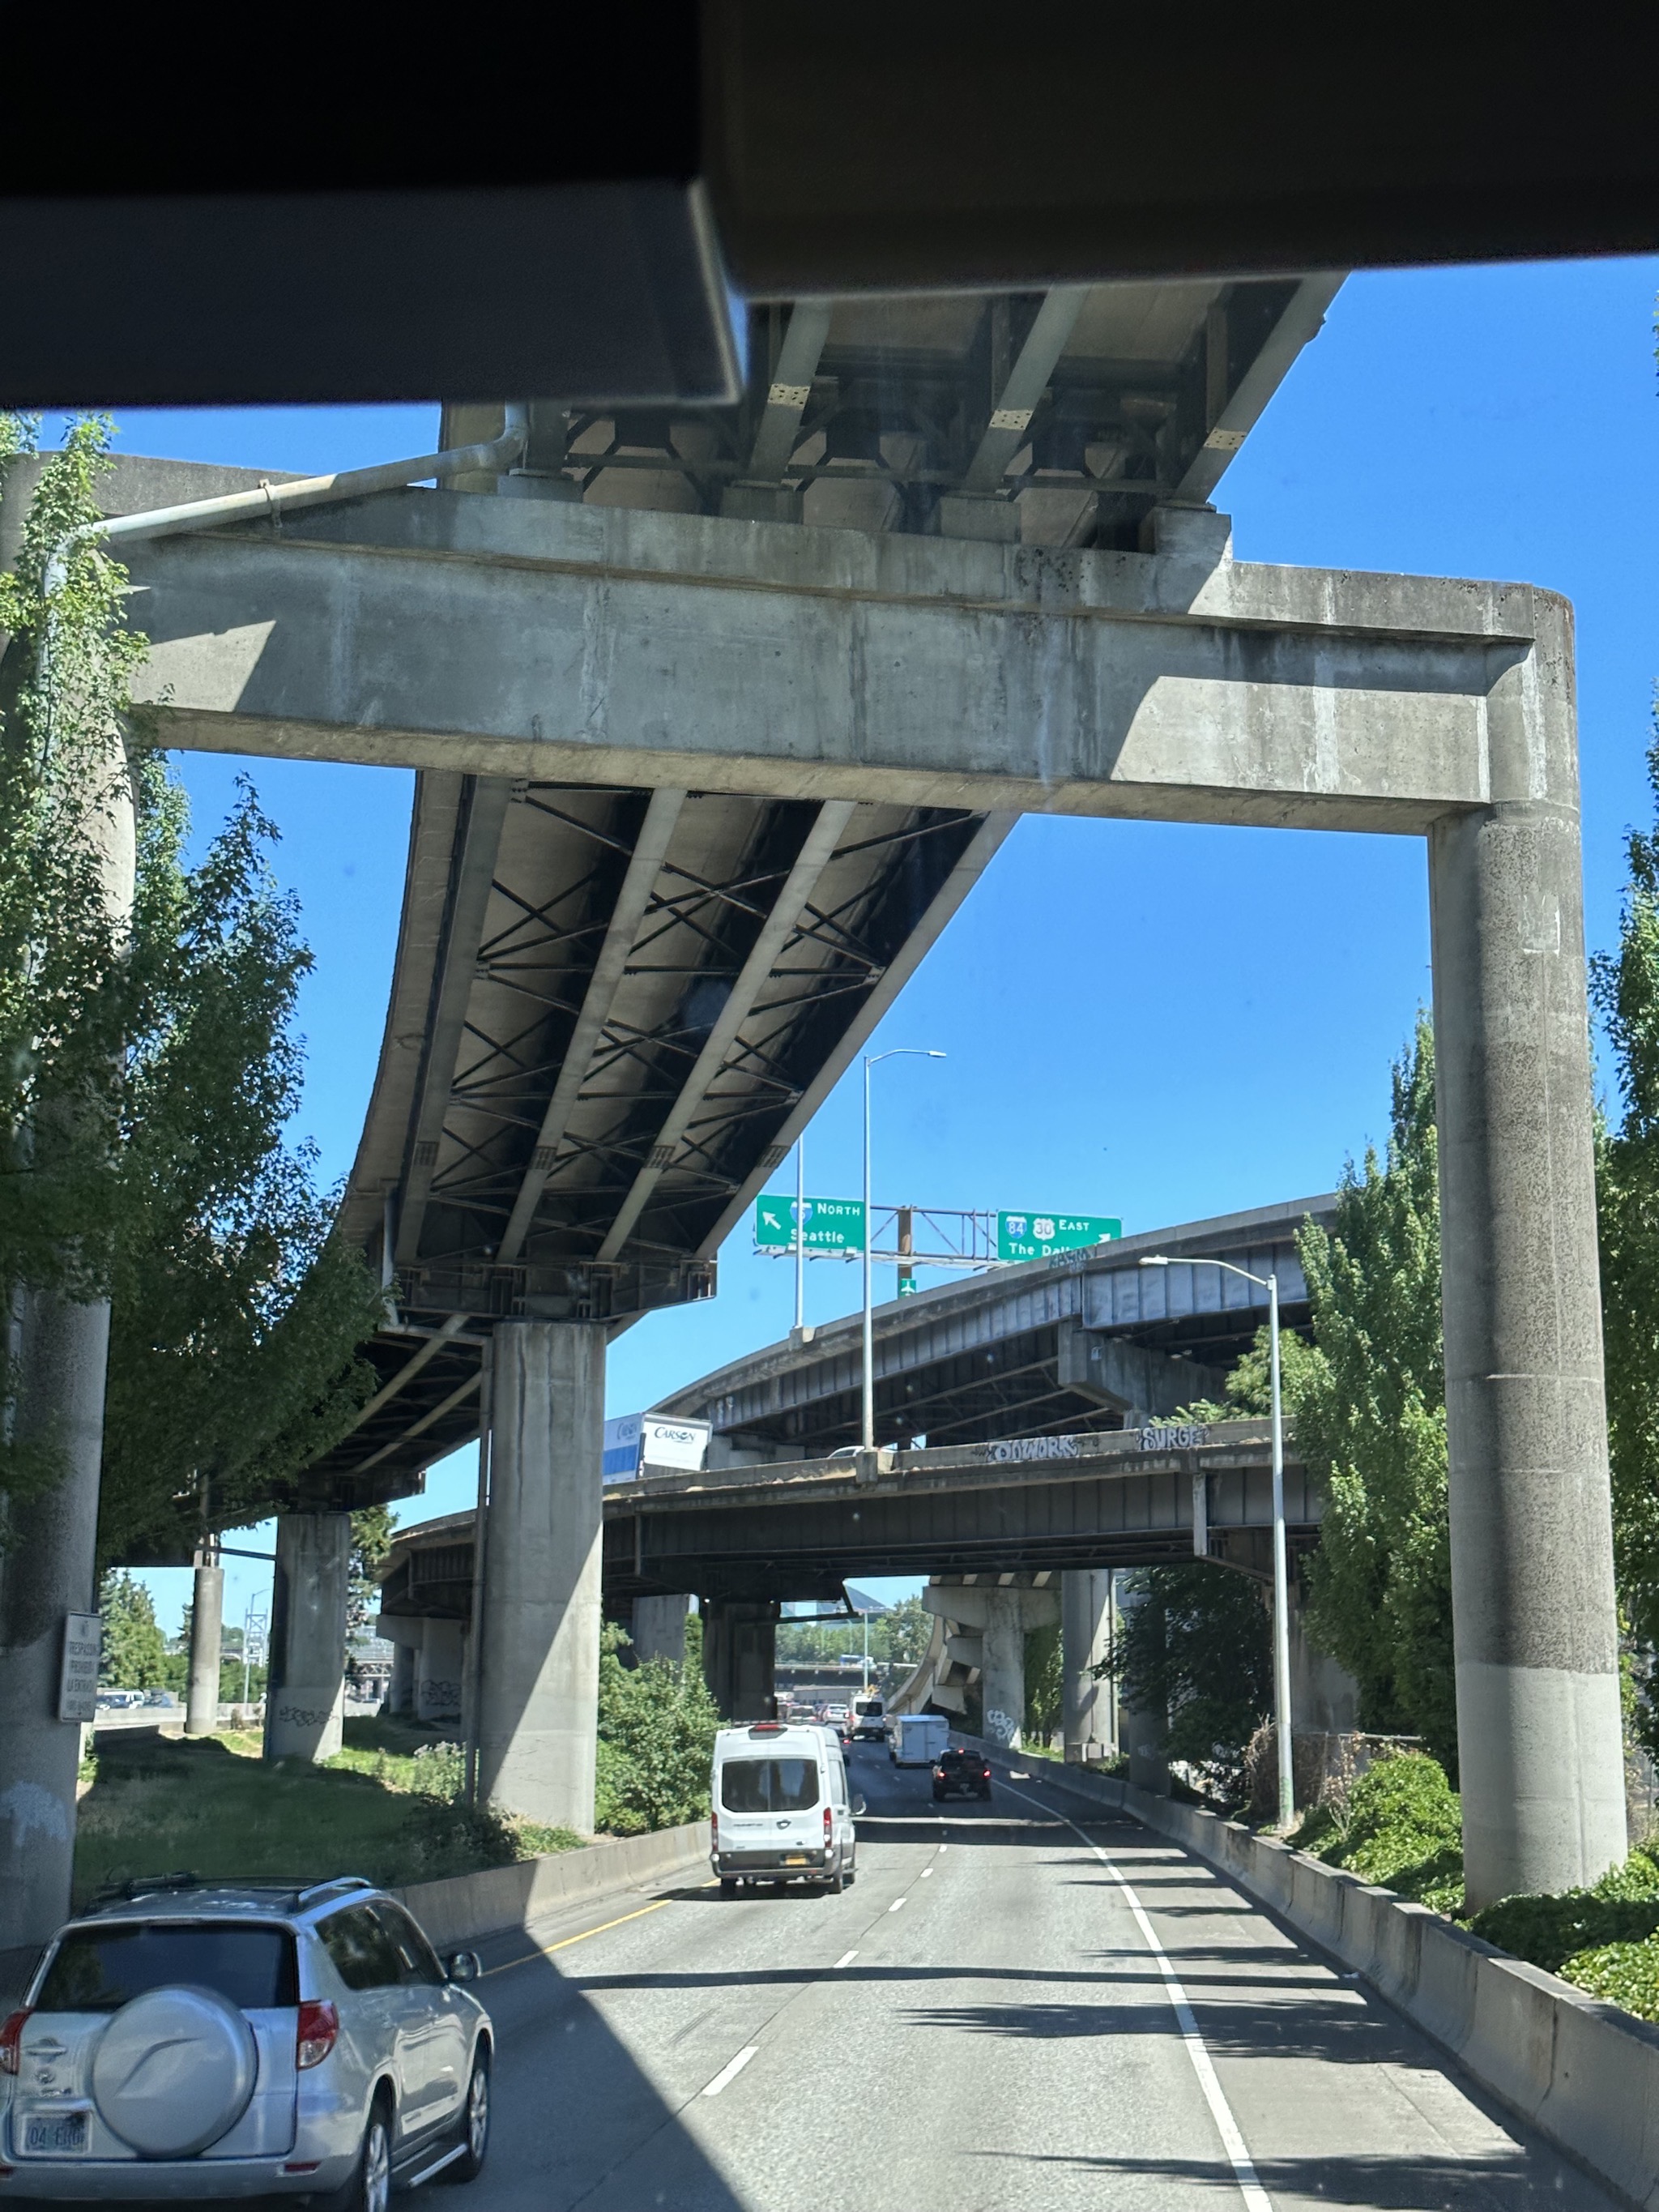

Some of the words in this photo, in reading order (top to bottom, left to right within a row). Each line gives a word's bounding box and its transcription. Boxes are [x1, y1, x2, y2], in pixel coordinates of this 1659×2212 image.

[817, 1202, 860, 1215] NORTH
[1009, 1223, 1024, 1234] 84
[1036, 1222, 1052, 1235] 30
[1059, 1219, 1090, 1231] EAST
[791, 1228, 845, 1243] Seattle
[1009, 1242, 1034, 1255] The
